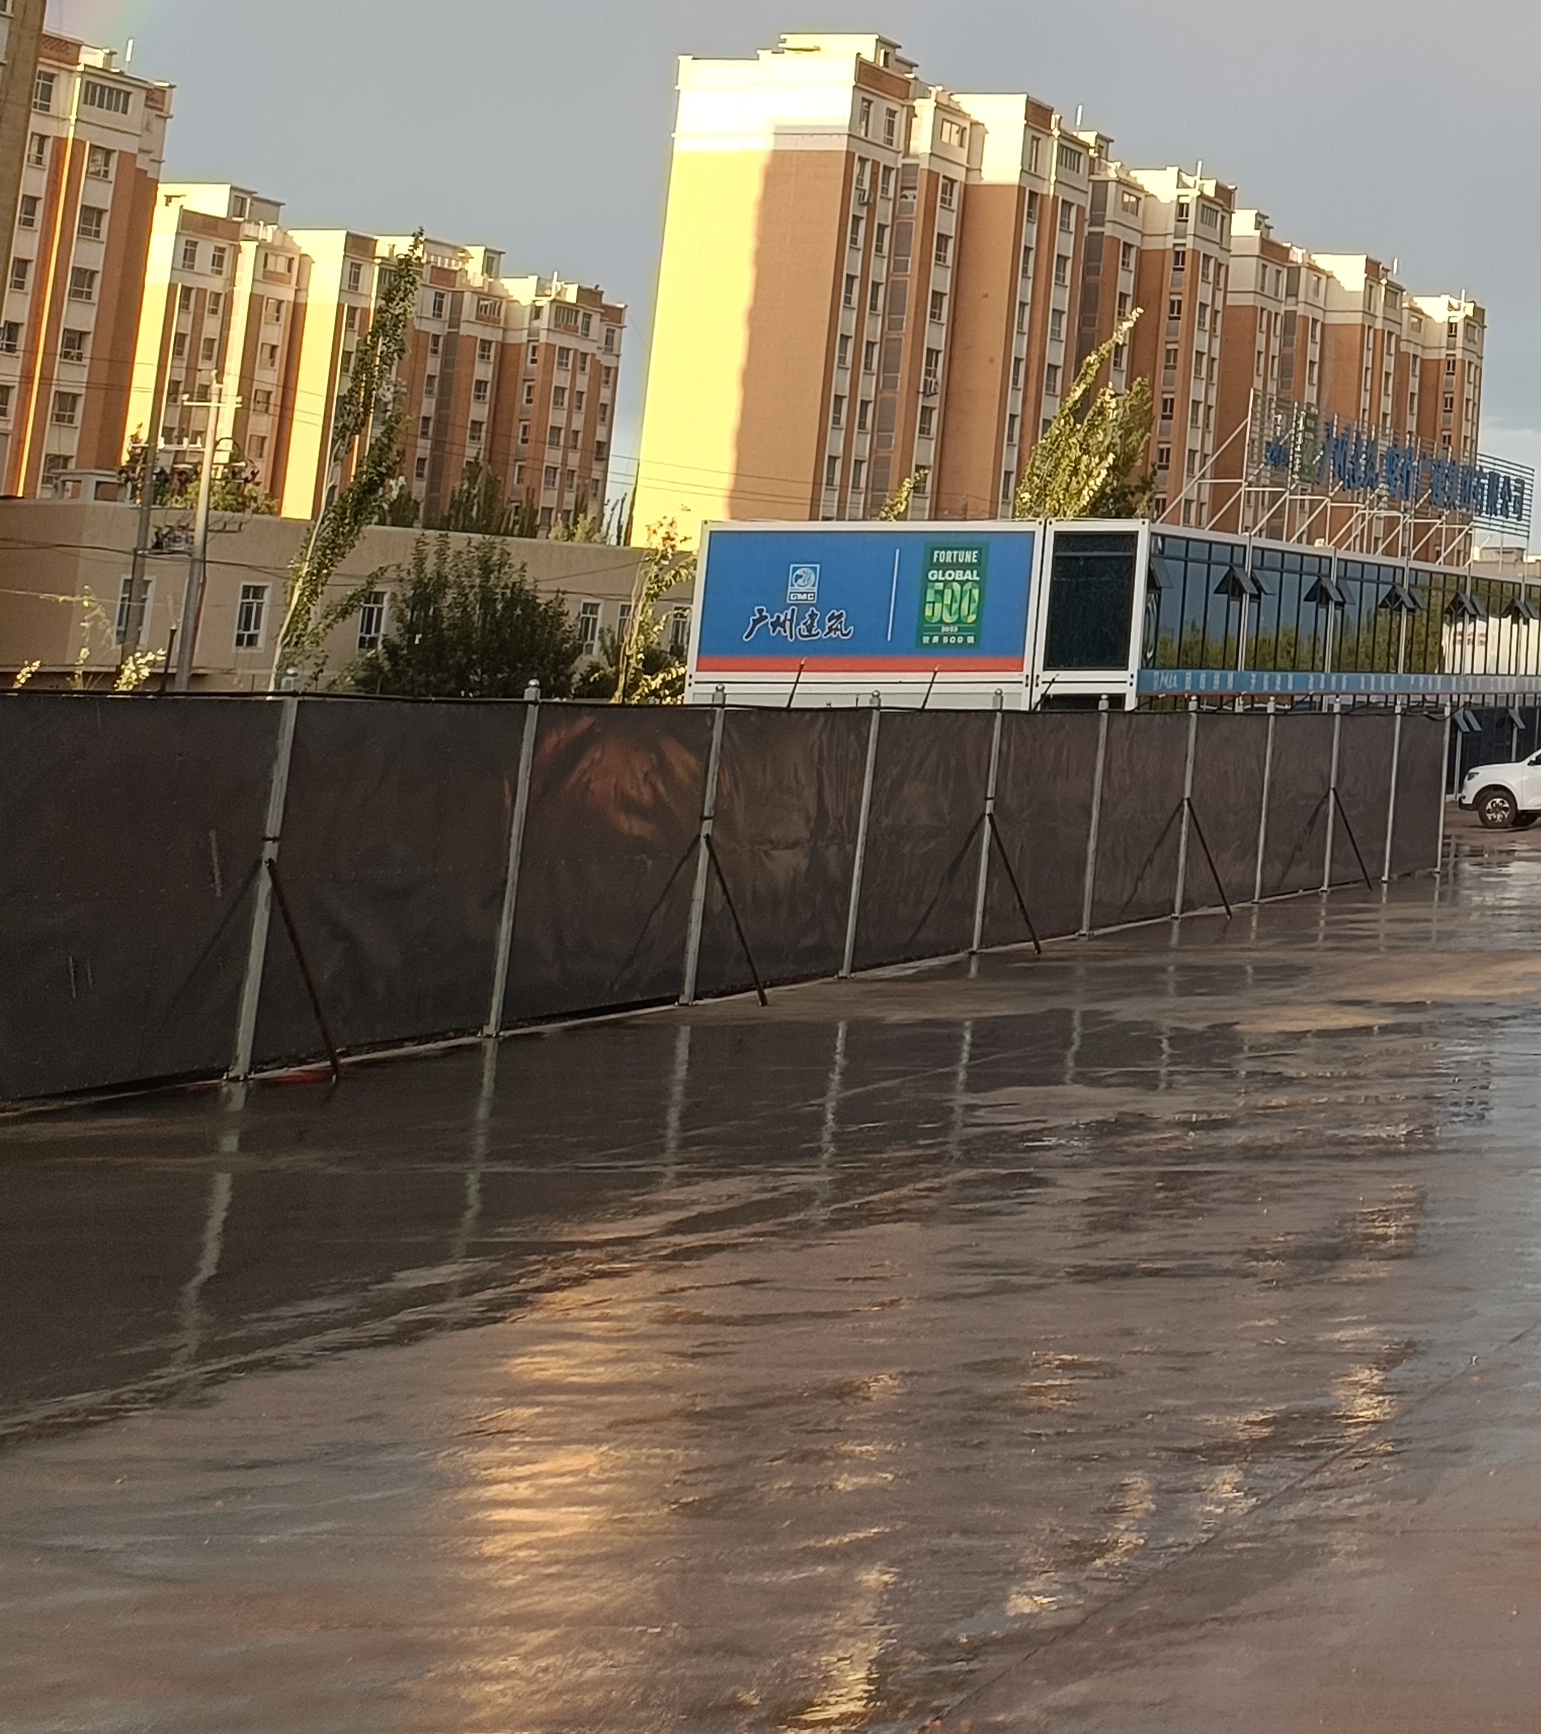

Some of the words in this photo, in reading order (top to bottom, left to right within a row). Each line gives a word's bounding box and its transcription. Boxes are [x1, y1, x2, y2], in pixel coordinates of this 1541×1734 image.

[933, 550, 979, 563] FORTUNE
[928, 569, 980, 581] GLOBAL
[924, 581, 980, 624] 500
[742, 605, 854, 642] 广州建筑
